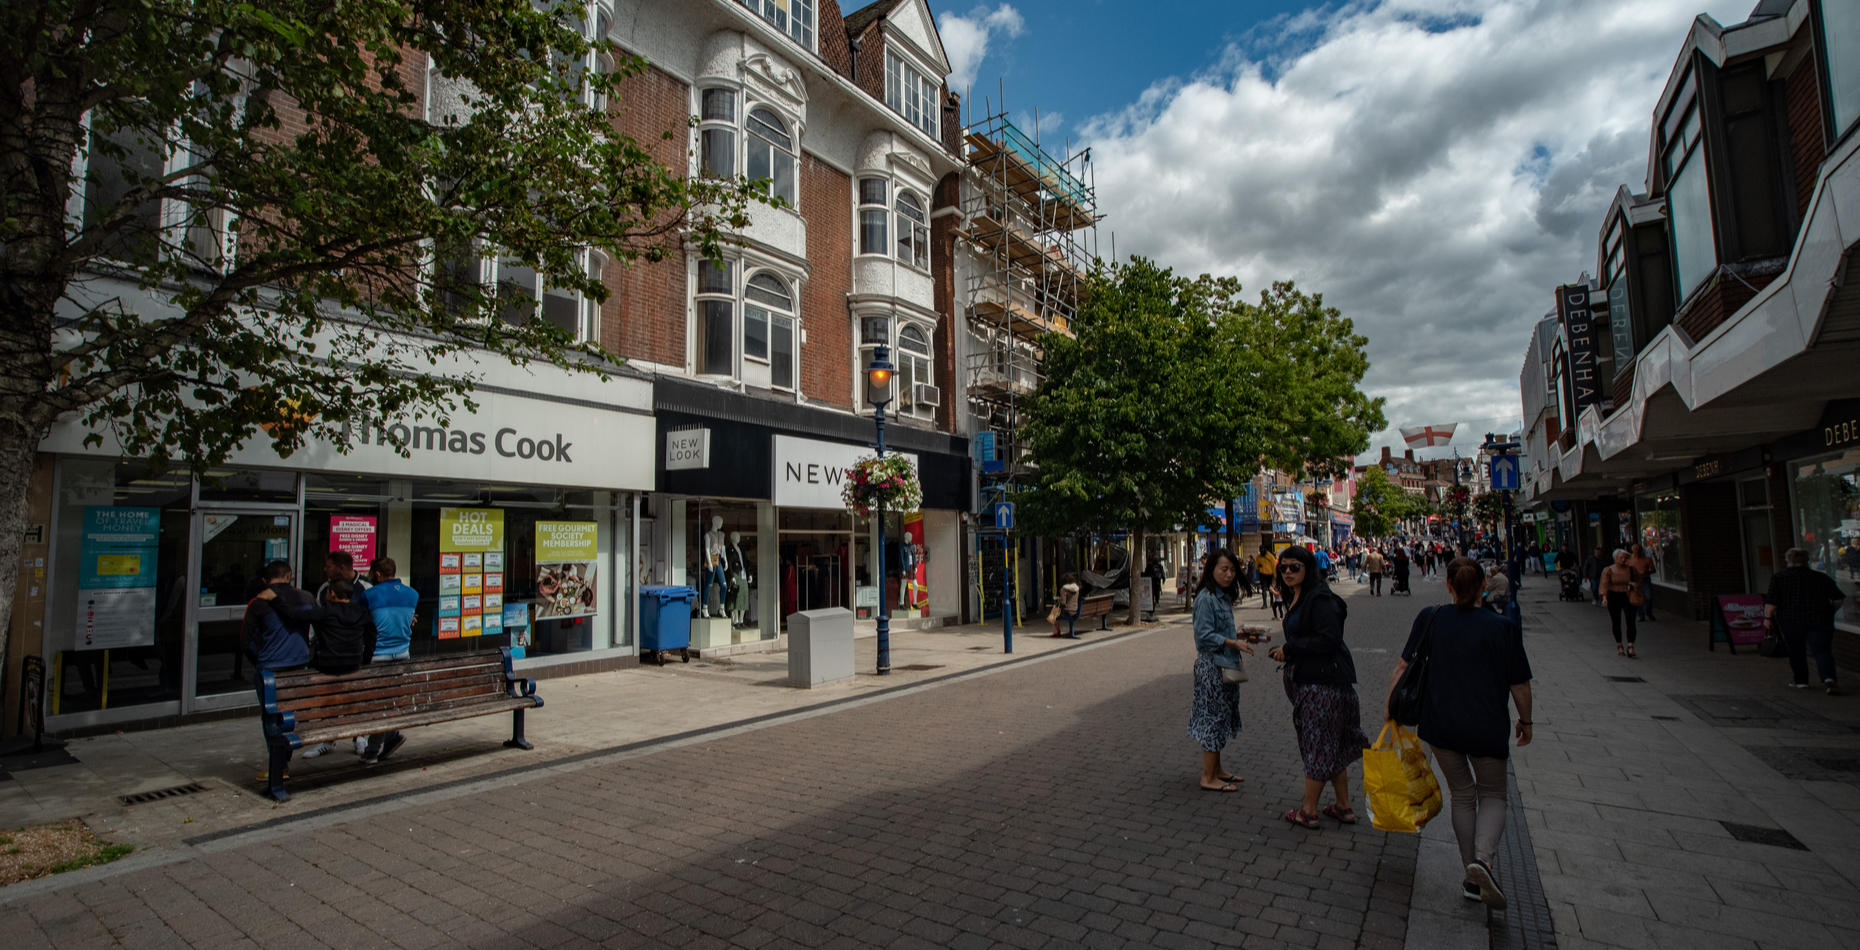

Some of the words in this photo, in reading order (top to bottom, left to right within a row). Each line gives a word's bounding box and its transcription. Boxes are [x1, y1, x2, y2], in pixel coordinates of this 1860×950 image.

[1568, 293, 1595, 409] DEBENHA
[1825, 419, 1859, 447] DEBE
[494, 427, 573, 463] Cook
[672, 438, 698, 450] NEW
[669, 449, 700, 461] LOOK
[786, 462, 843, 486] NEW
[459, 511, 487, 523] HOT
[452, 523, 493, 535] DEALS
[539, 524, 557, 532] FREE
[558, 524, 595, 533] GOURMET
[551, 532, 584, 540] SOCIETY
[543, 539, 592, 548] MEMBERSHIP
[913, 543, 923, 553] 0%
